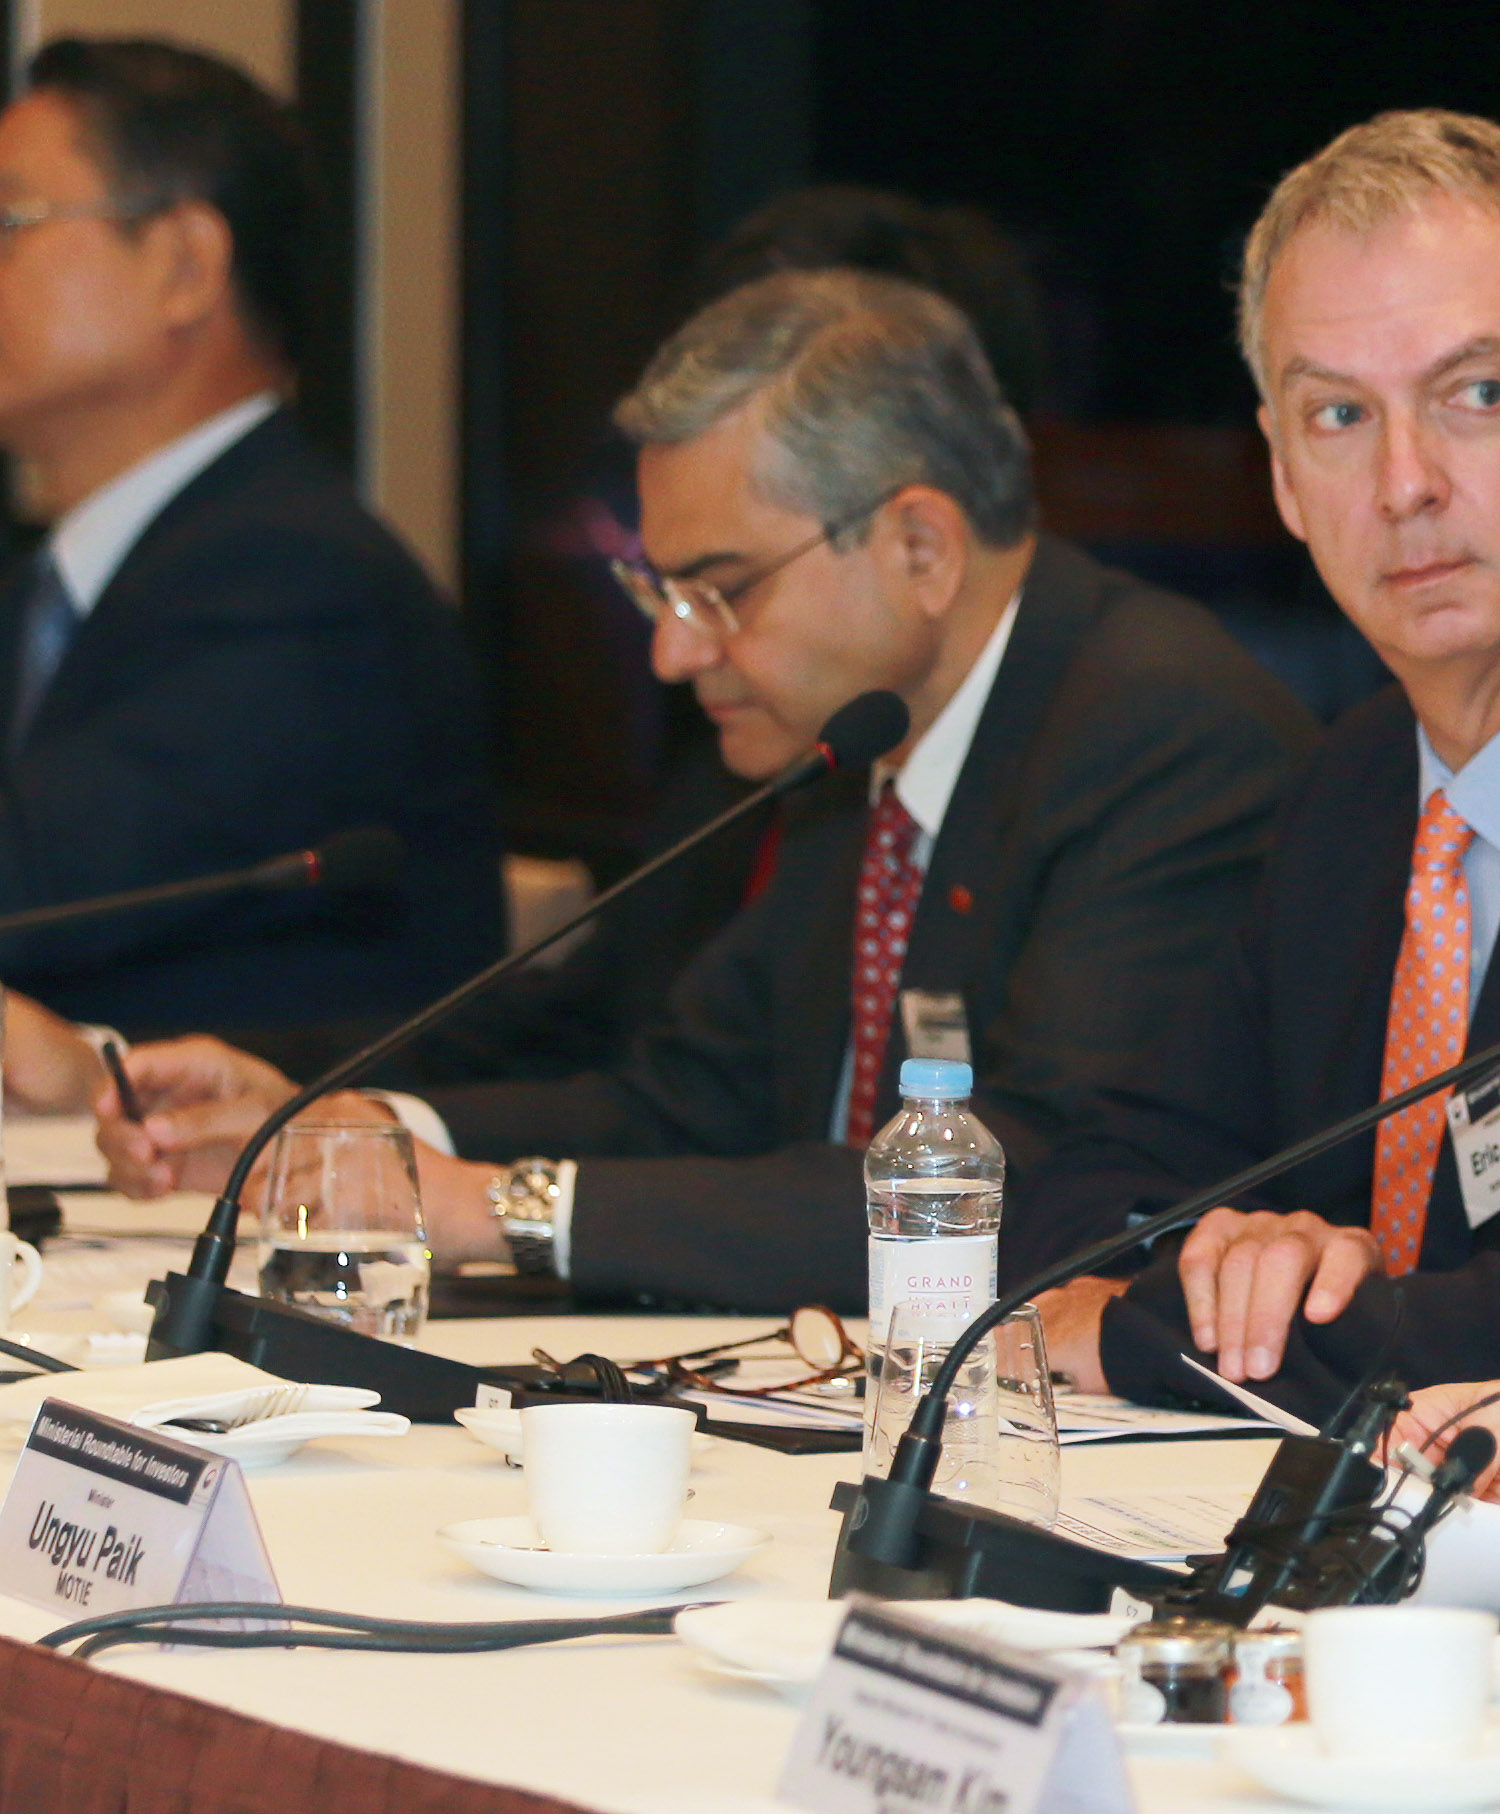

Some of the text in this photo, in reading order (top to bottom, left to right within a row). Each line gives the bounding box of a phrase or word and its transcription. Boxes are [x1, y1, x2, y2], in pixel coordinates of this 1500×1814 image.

[1470, 1142, 1500, 1176] Eric
[907, 1275, 973, 1288] GRAND
[35, 1415, 190, 1488] Ministerial Roundtable for Investors
[28, 1499, 146, 1586] Ungyu Paik
[54, 1570, 94, 1606] MOTIE
